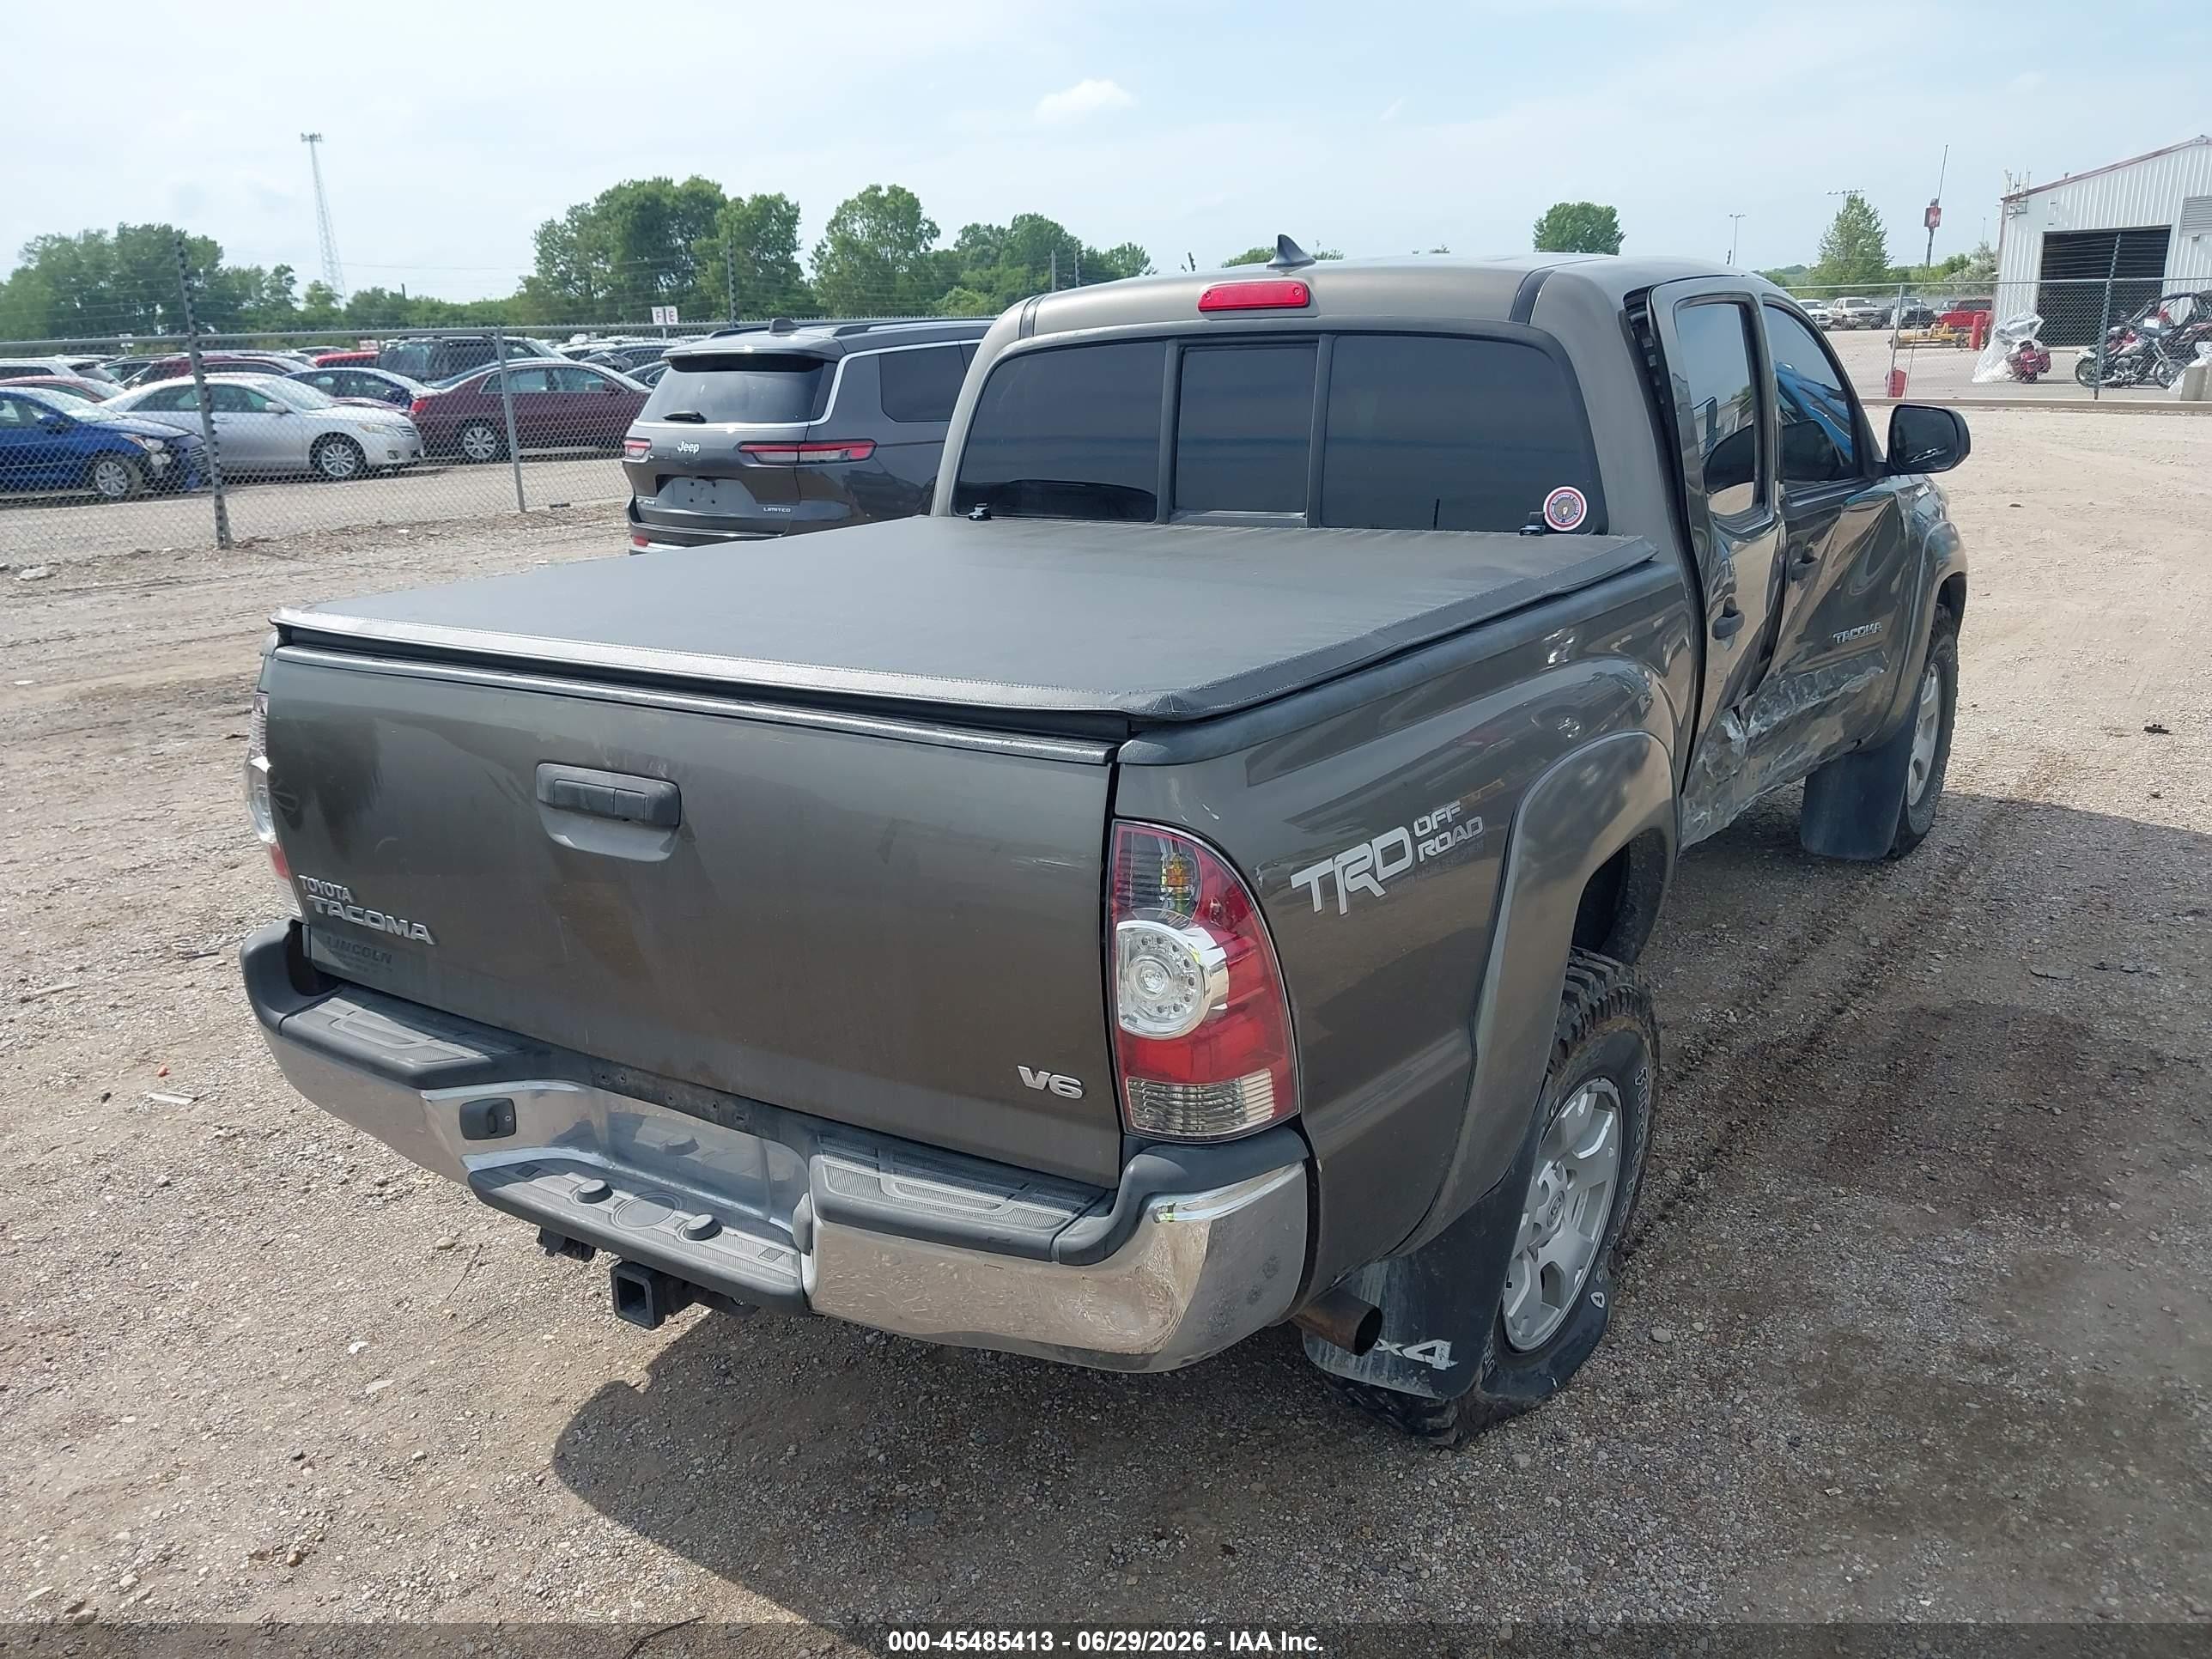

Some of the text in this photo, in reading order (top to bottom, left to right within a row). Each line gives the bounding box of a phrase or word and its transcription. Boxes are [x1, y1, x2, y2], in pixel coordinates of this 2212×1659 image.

[677, 441, 700, 454] Jeep
[1832, 621, 1883, 644] TACOMA
[1413, 800, 1462, 838] OFF
[1417, 816, 1484, 863] ROAD
[297, 874, 354, 903] TOYOTA
[1290, 826, 1413, 915] TRD
[306, 894, 435, 945] TACOMA
[1017, 1065, 1083, 1099] V6
